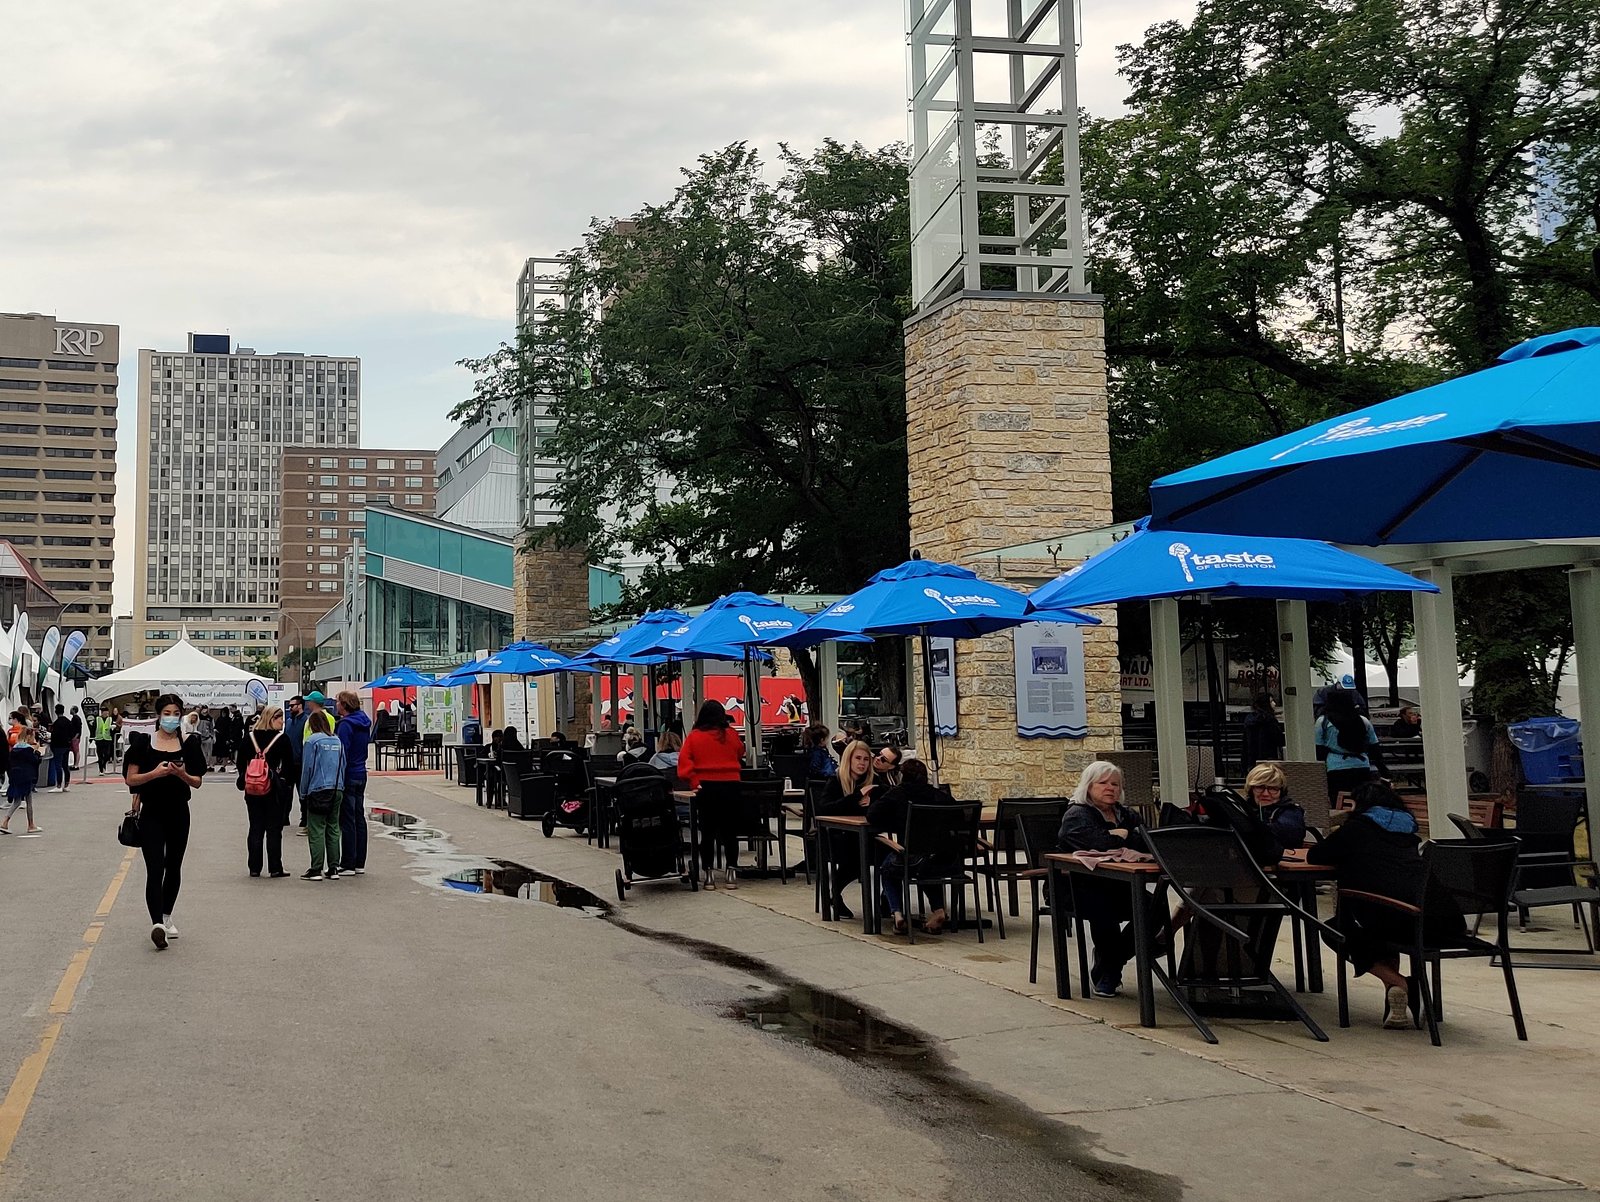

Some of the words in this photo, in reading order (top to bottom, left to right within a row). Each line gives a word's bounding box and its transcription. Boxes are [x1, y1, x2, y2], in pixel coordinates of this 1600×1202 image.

[1190, 551, 1274, 565] taste
[943, 594, 998, 604] taste
[752, 619, 793, 628] taste
[1134, 677, 1151, 687] LTD.
